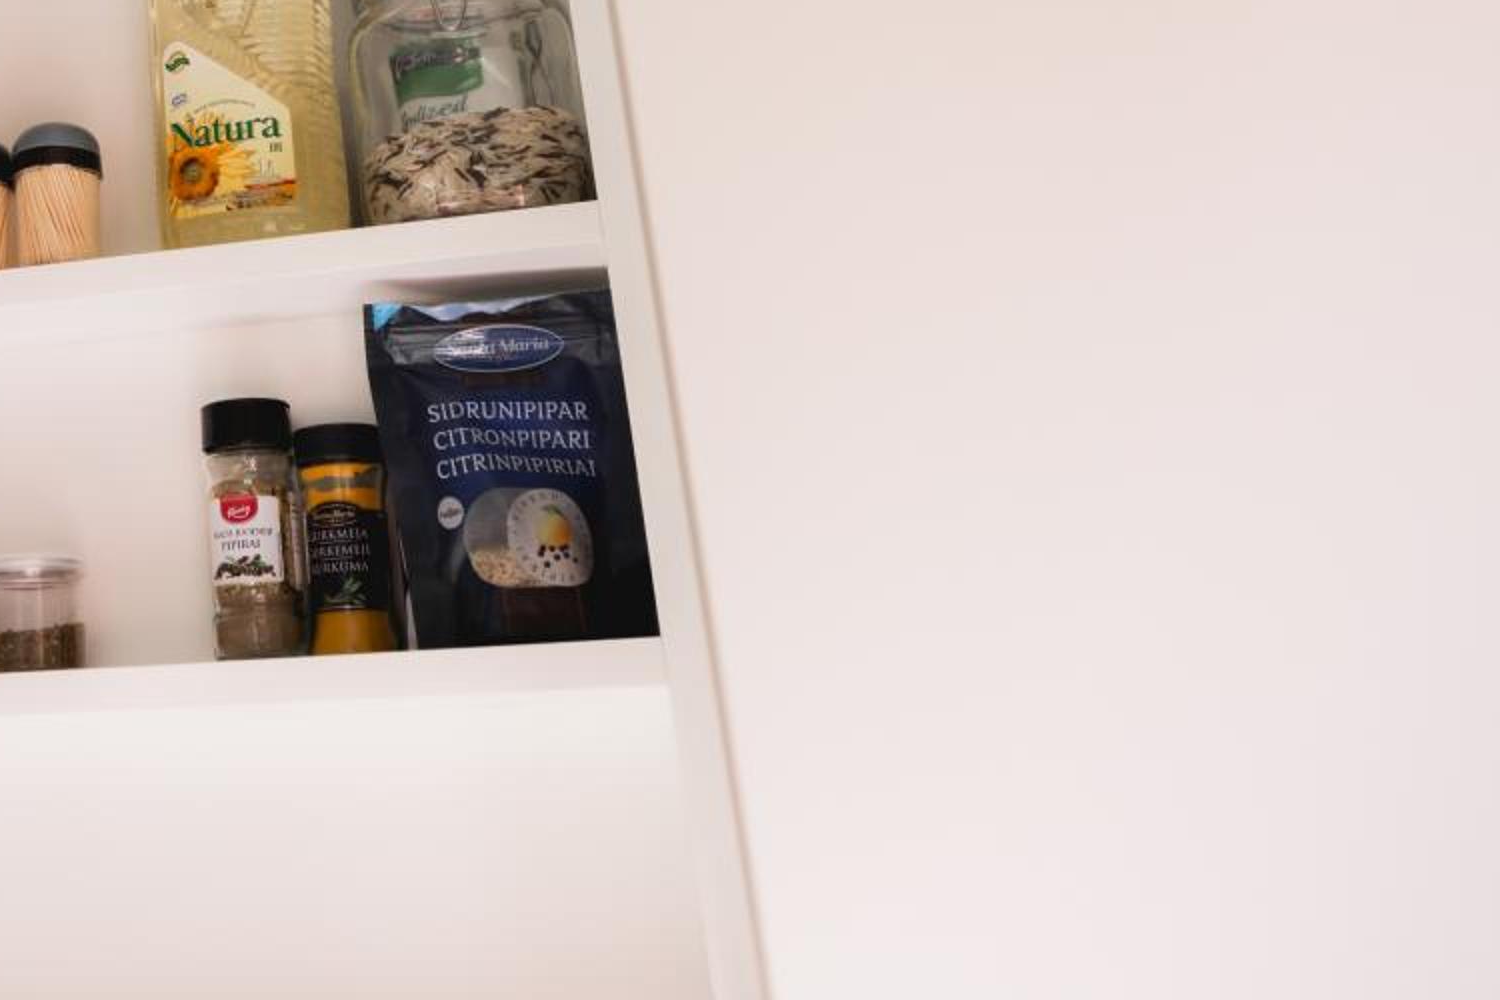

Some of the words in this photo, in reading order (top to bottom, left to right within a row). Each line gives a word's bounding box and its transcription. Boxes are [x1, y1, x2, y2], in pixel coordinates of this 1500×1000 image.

[171, 114, 282, 147] Natura
[498, 337, 550, 354] Maria
[427, 400, 589, 423] SIDRUNIPIPAR
[432, 427, 591, 450] CITRONPIPARI
[436, 452, 597, 480] CITRINPIPIRIAI
